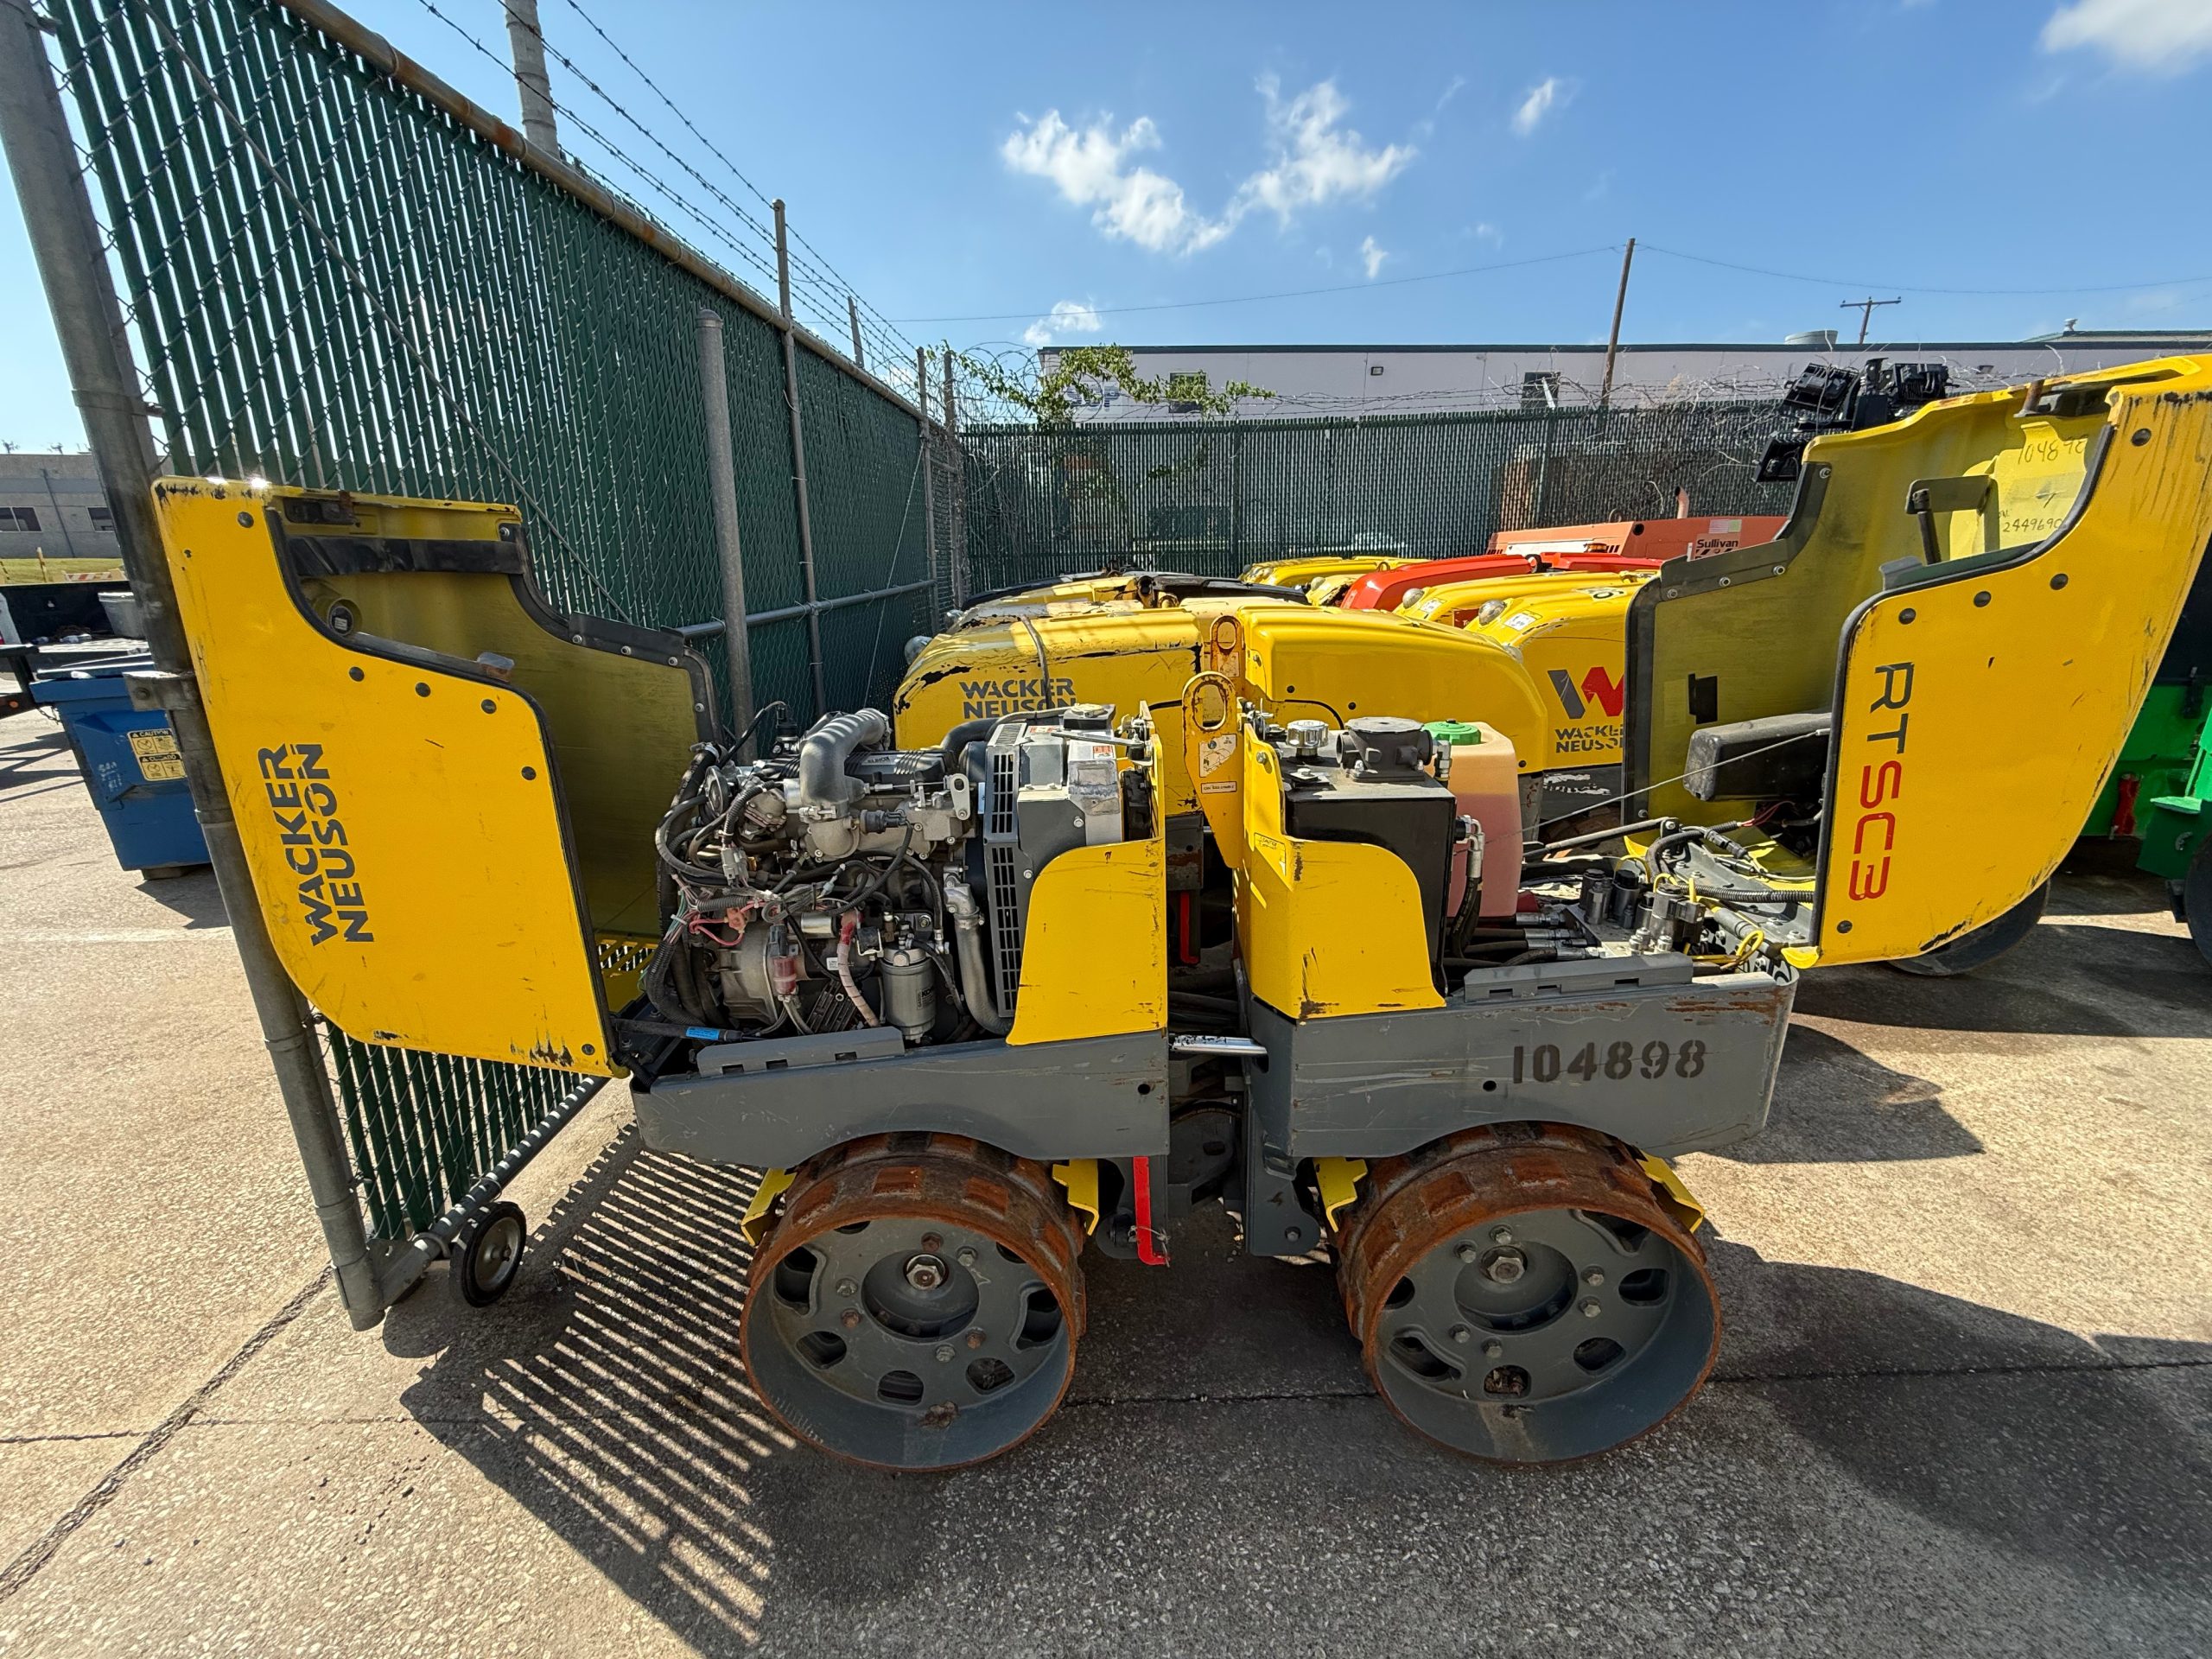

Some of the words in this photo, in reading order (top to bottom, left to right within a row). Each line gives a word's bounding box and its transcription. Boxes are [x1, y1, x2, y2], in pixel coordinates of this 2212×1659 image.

[1696, 538, 1738, 549] Sullivan
[959, 677, 1076, 699] WACKER
[257, 742, 339, 947] WACKER
[289, 743, 374, 943] NEUSON
[1513, 1039, 1707, 1084] 104898
